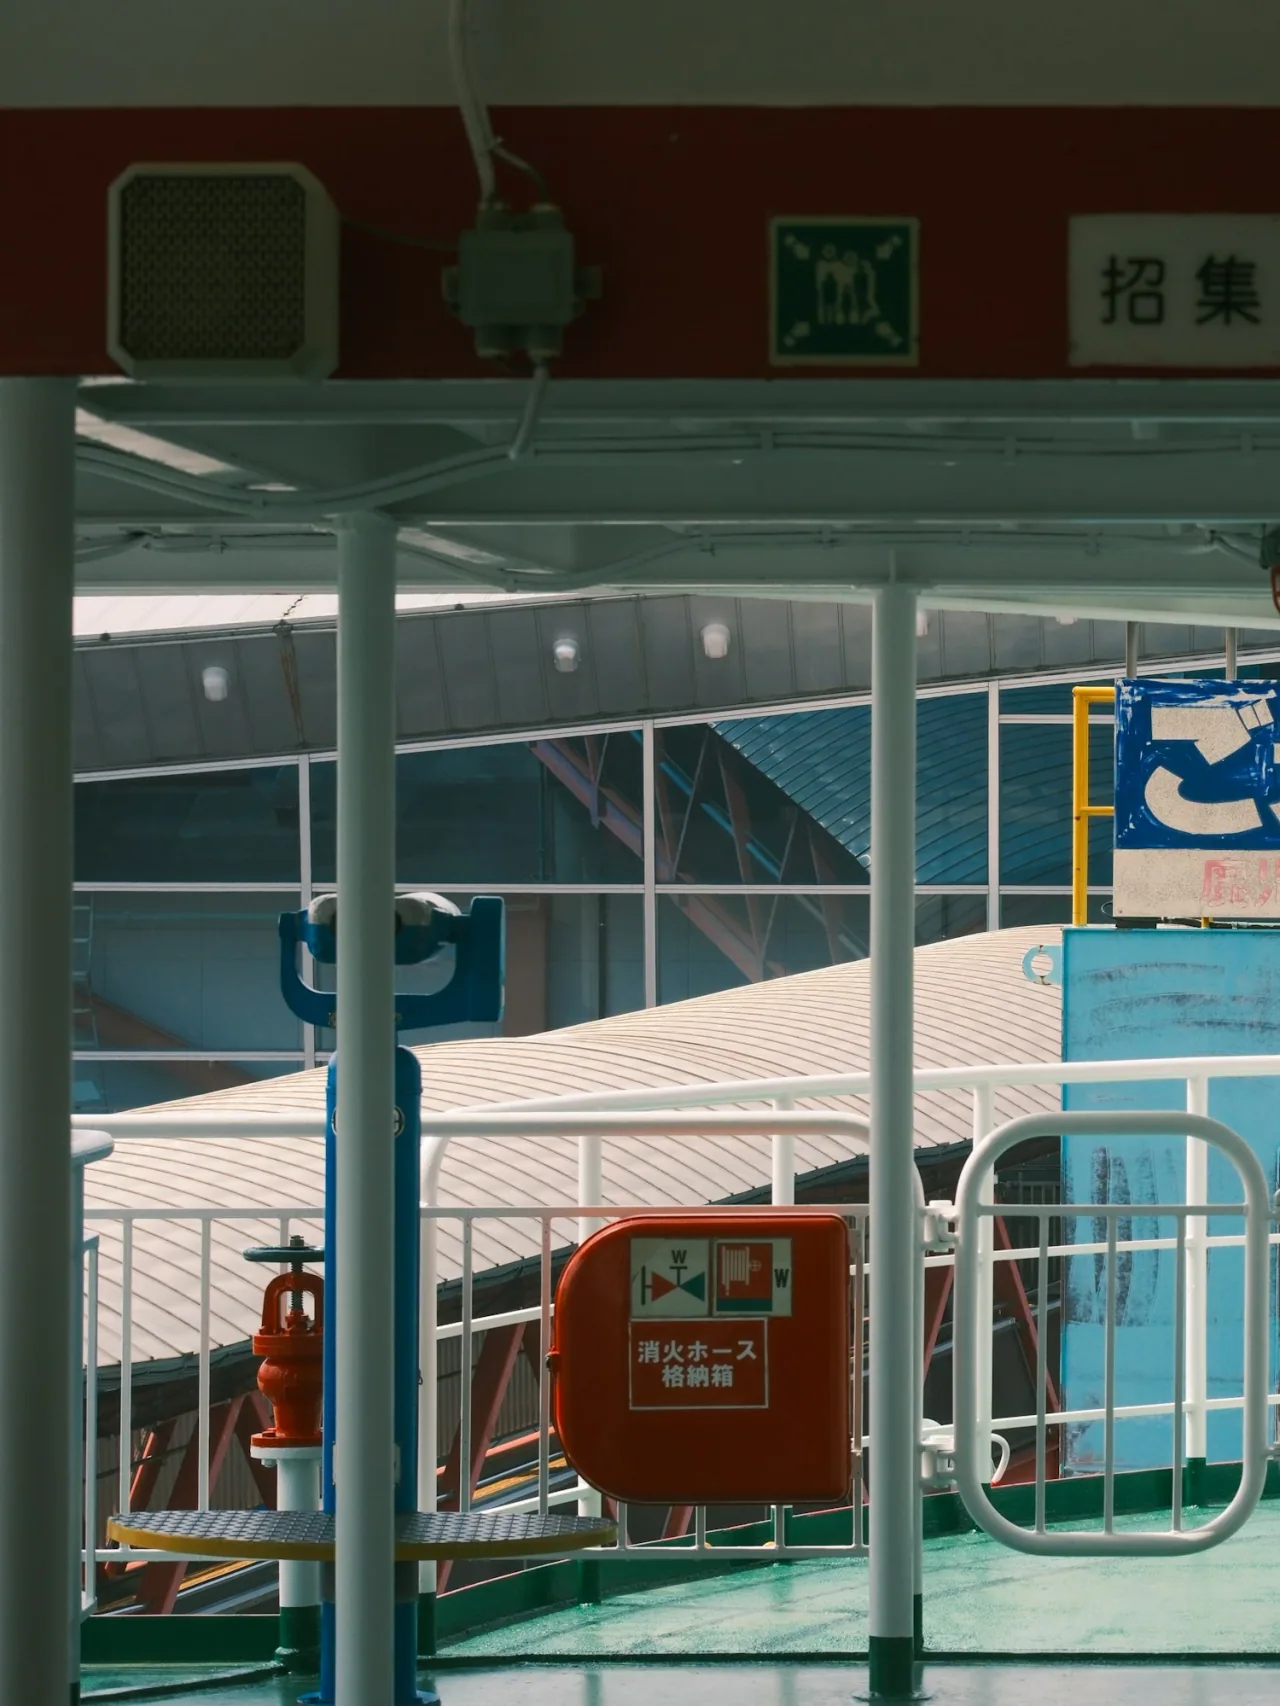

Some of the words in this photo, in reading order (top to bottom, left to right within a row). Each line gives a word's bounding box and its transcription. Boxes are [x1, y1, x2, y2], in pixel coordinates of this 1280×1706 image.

[671, 1249, 687, 1264] W
[774, 1268, 789, 1288] W
[637, 1339, 757, 1364] 消火ホース
[661, 1364, 734, 1388] 格納箱
